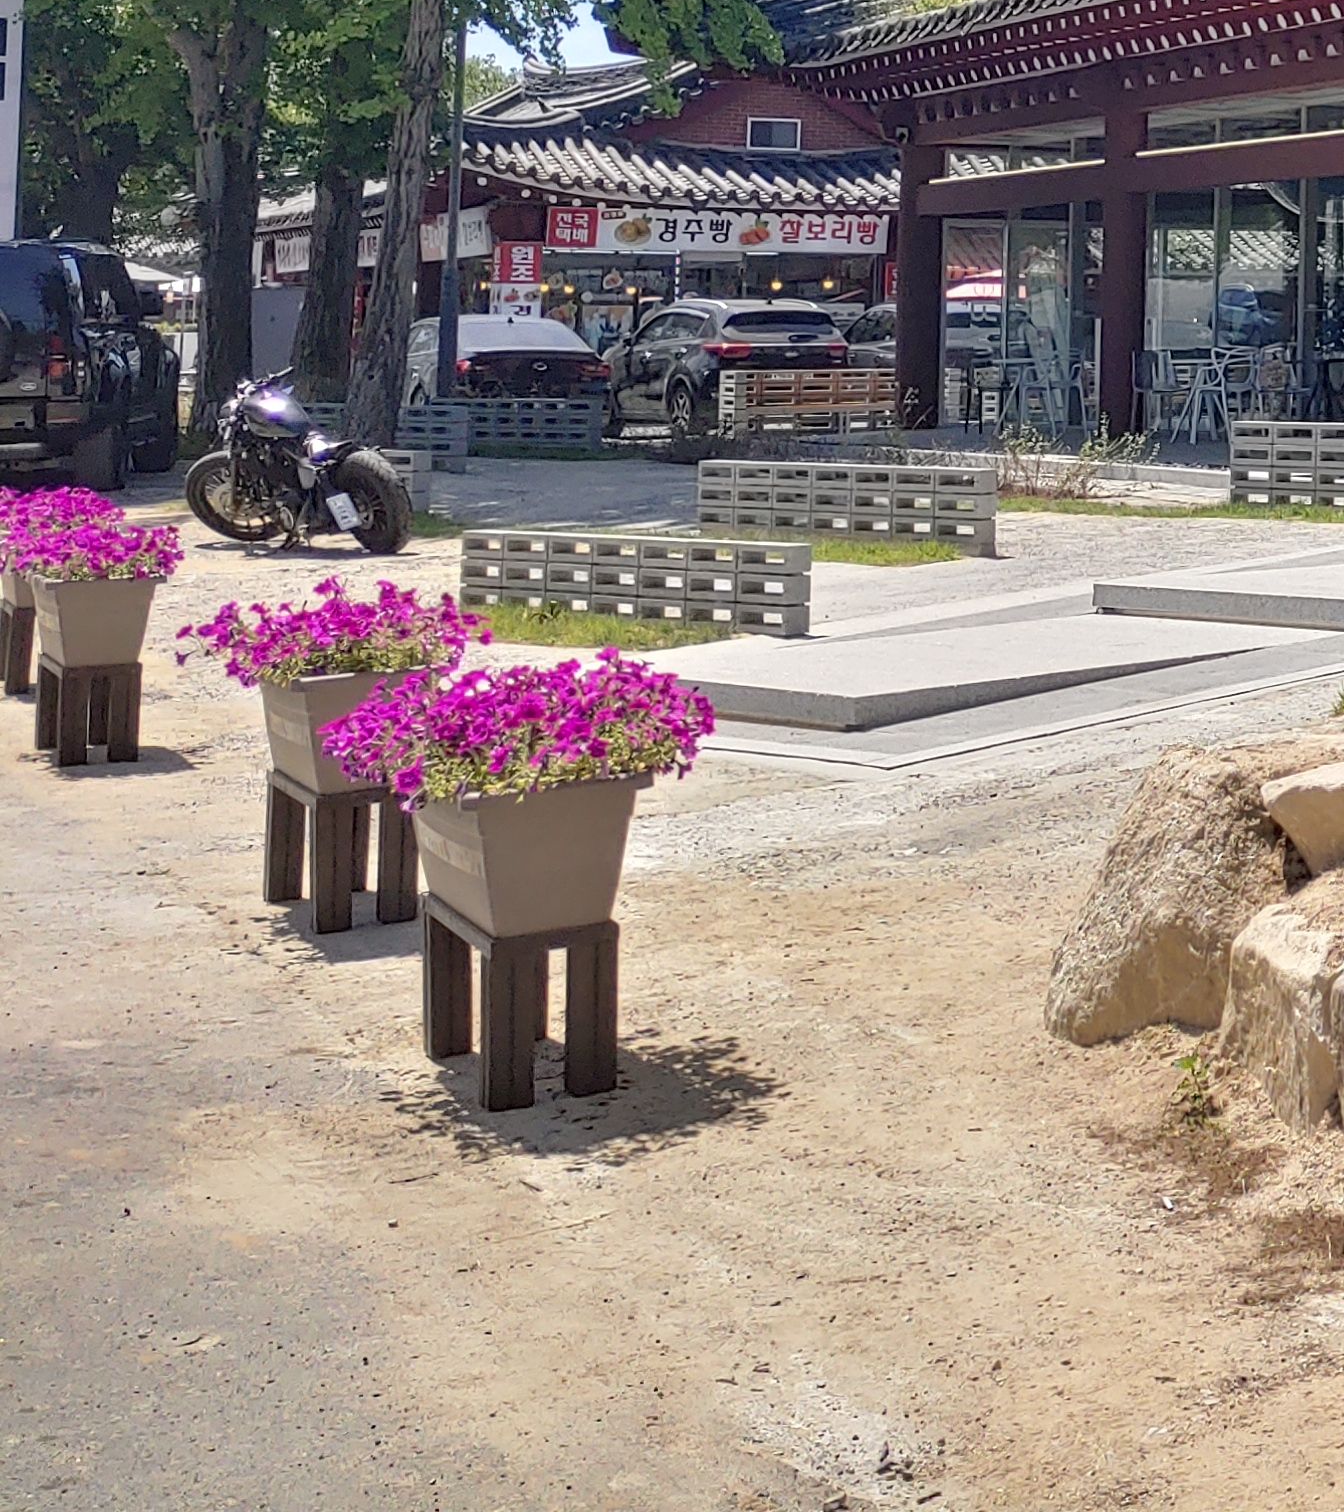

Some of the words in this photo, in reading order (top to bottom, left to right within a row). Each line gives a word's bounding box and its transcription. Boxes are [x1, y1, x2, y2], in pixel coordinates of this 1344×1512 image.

[556, 213, 589, 228] 전국
[656, 217, 733, 243] 경주빵
[779, 219, 880, 245] 찰보리빵
[510, 246, 535, 281] 원조
